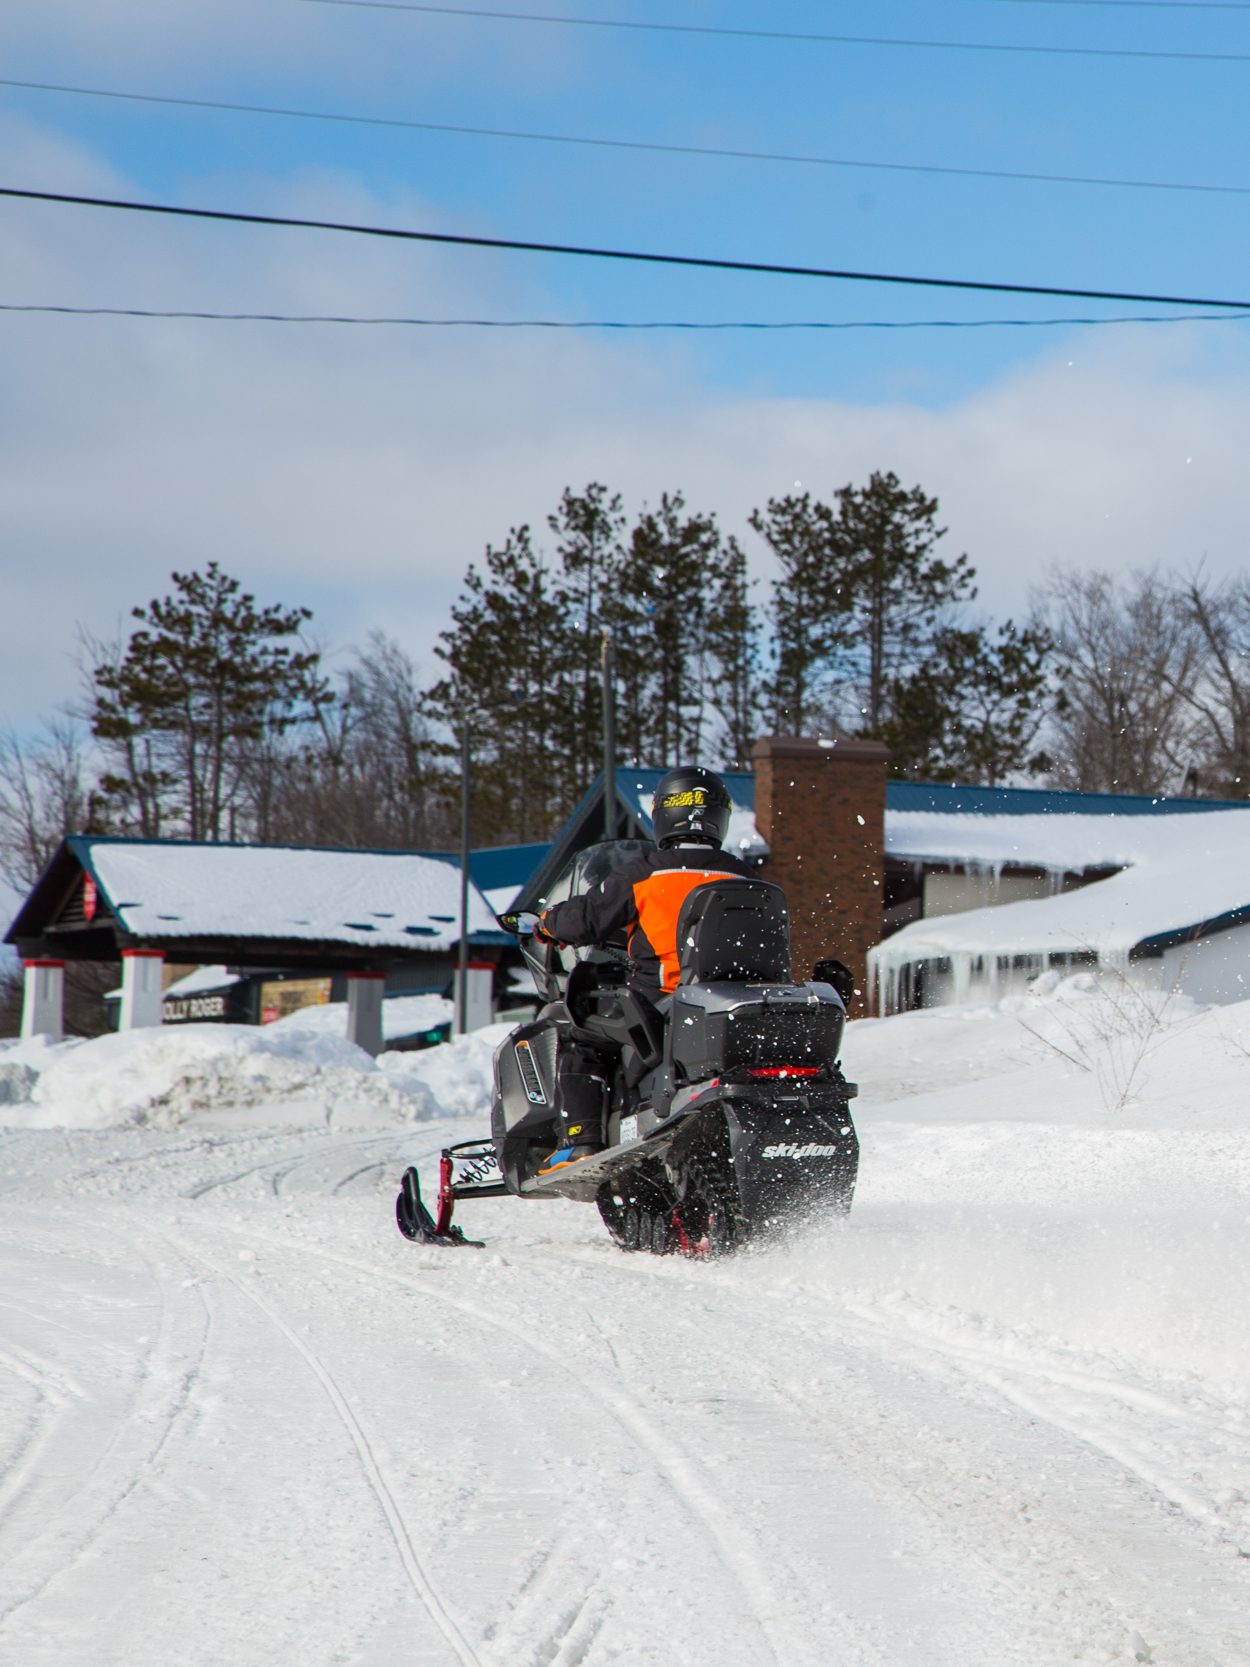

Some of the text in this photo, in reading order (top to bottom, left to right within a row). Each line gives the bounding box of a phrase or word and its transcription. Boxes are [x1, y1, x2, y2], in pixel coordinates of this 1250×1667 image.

[163, 996, 224, 1020] OLLY ROGER
[761, 1142, 837, 1158] ski-doo
